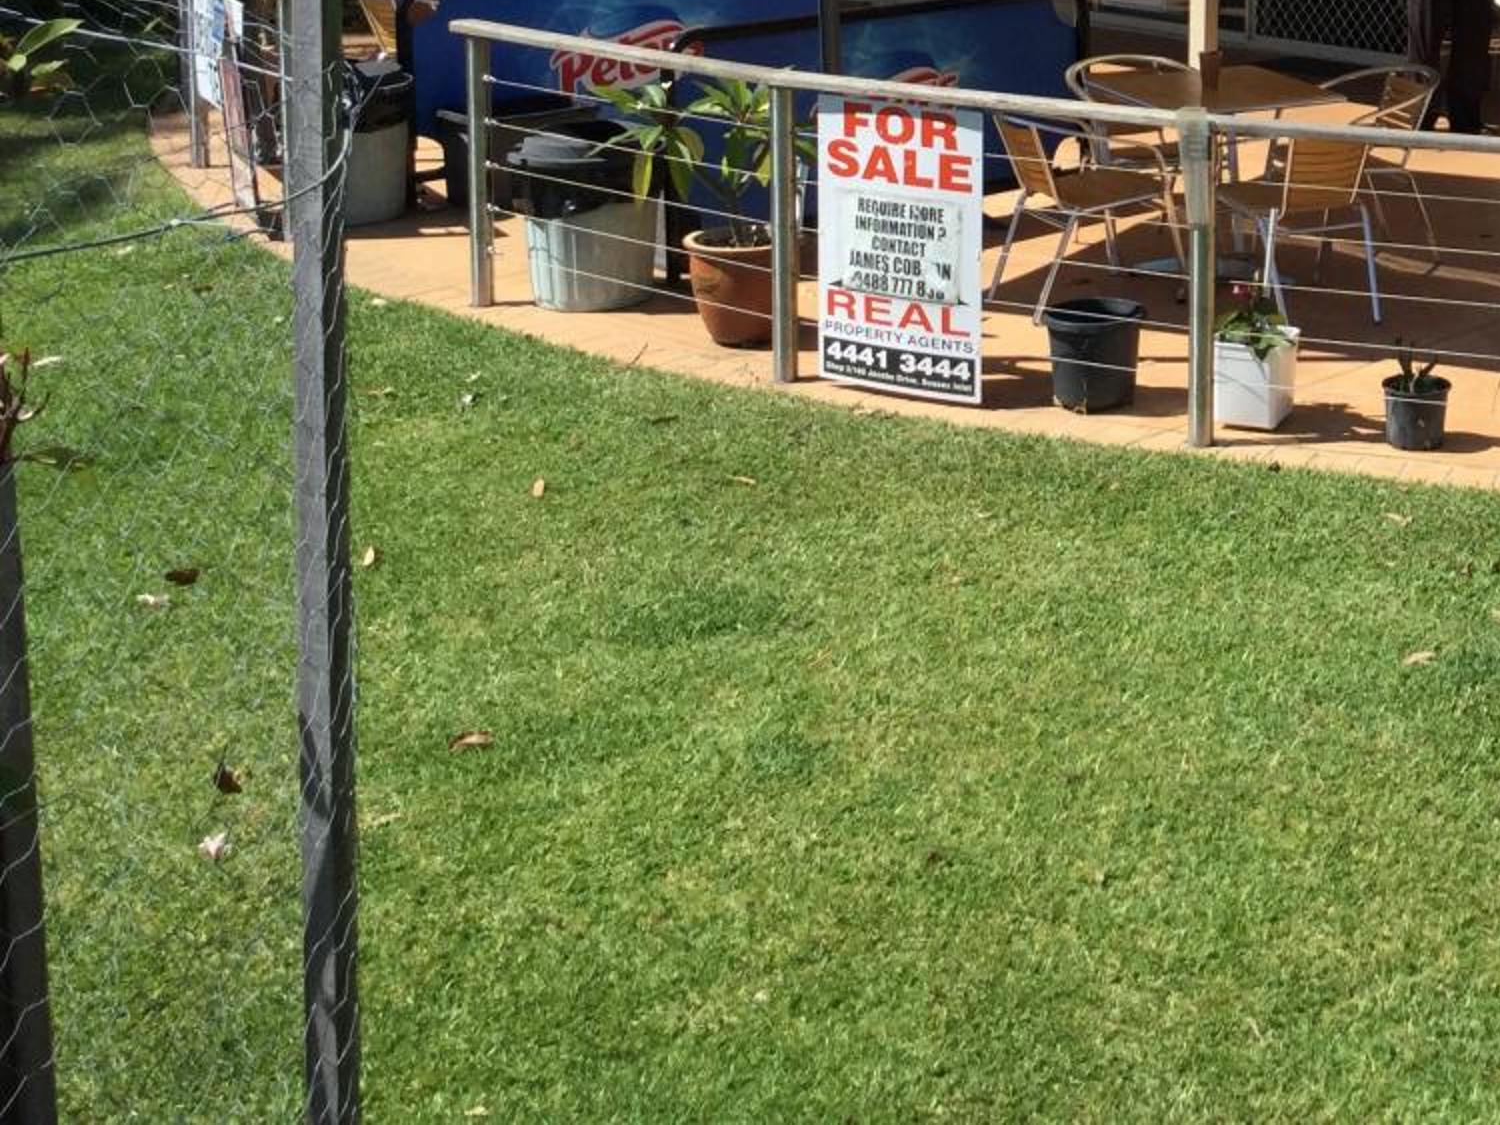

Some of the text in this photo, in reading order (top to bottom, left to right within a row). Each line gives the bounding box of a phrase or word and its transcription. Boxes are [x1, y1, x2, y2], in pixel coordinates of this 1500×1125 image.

[843, 101, 958, 151] FOR
[827, 138, 973, 193] SALE
[858, 197, 906, 219] REQUIRE
[855, 215, 934, 240] INFORMATION
[849, 250, 890, 274] JAMES
[871, 235, 926, 257] CONTACT
[827, 288, 971, 338] REAL
[824, 319, 974, 355] PROPERTY AGENTS
[827, 341, 971, 382] 4441 3444
